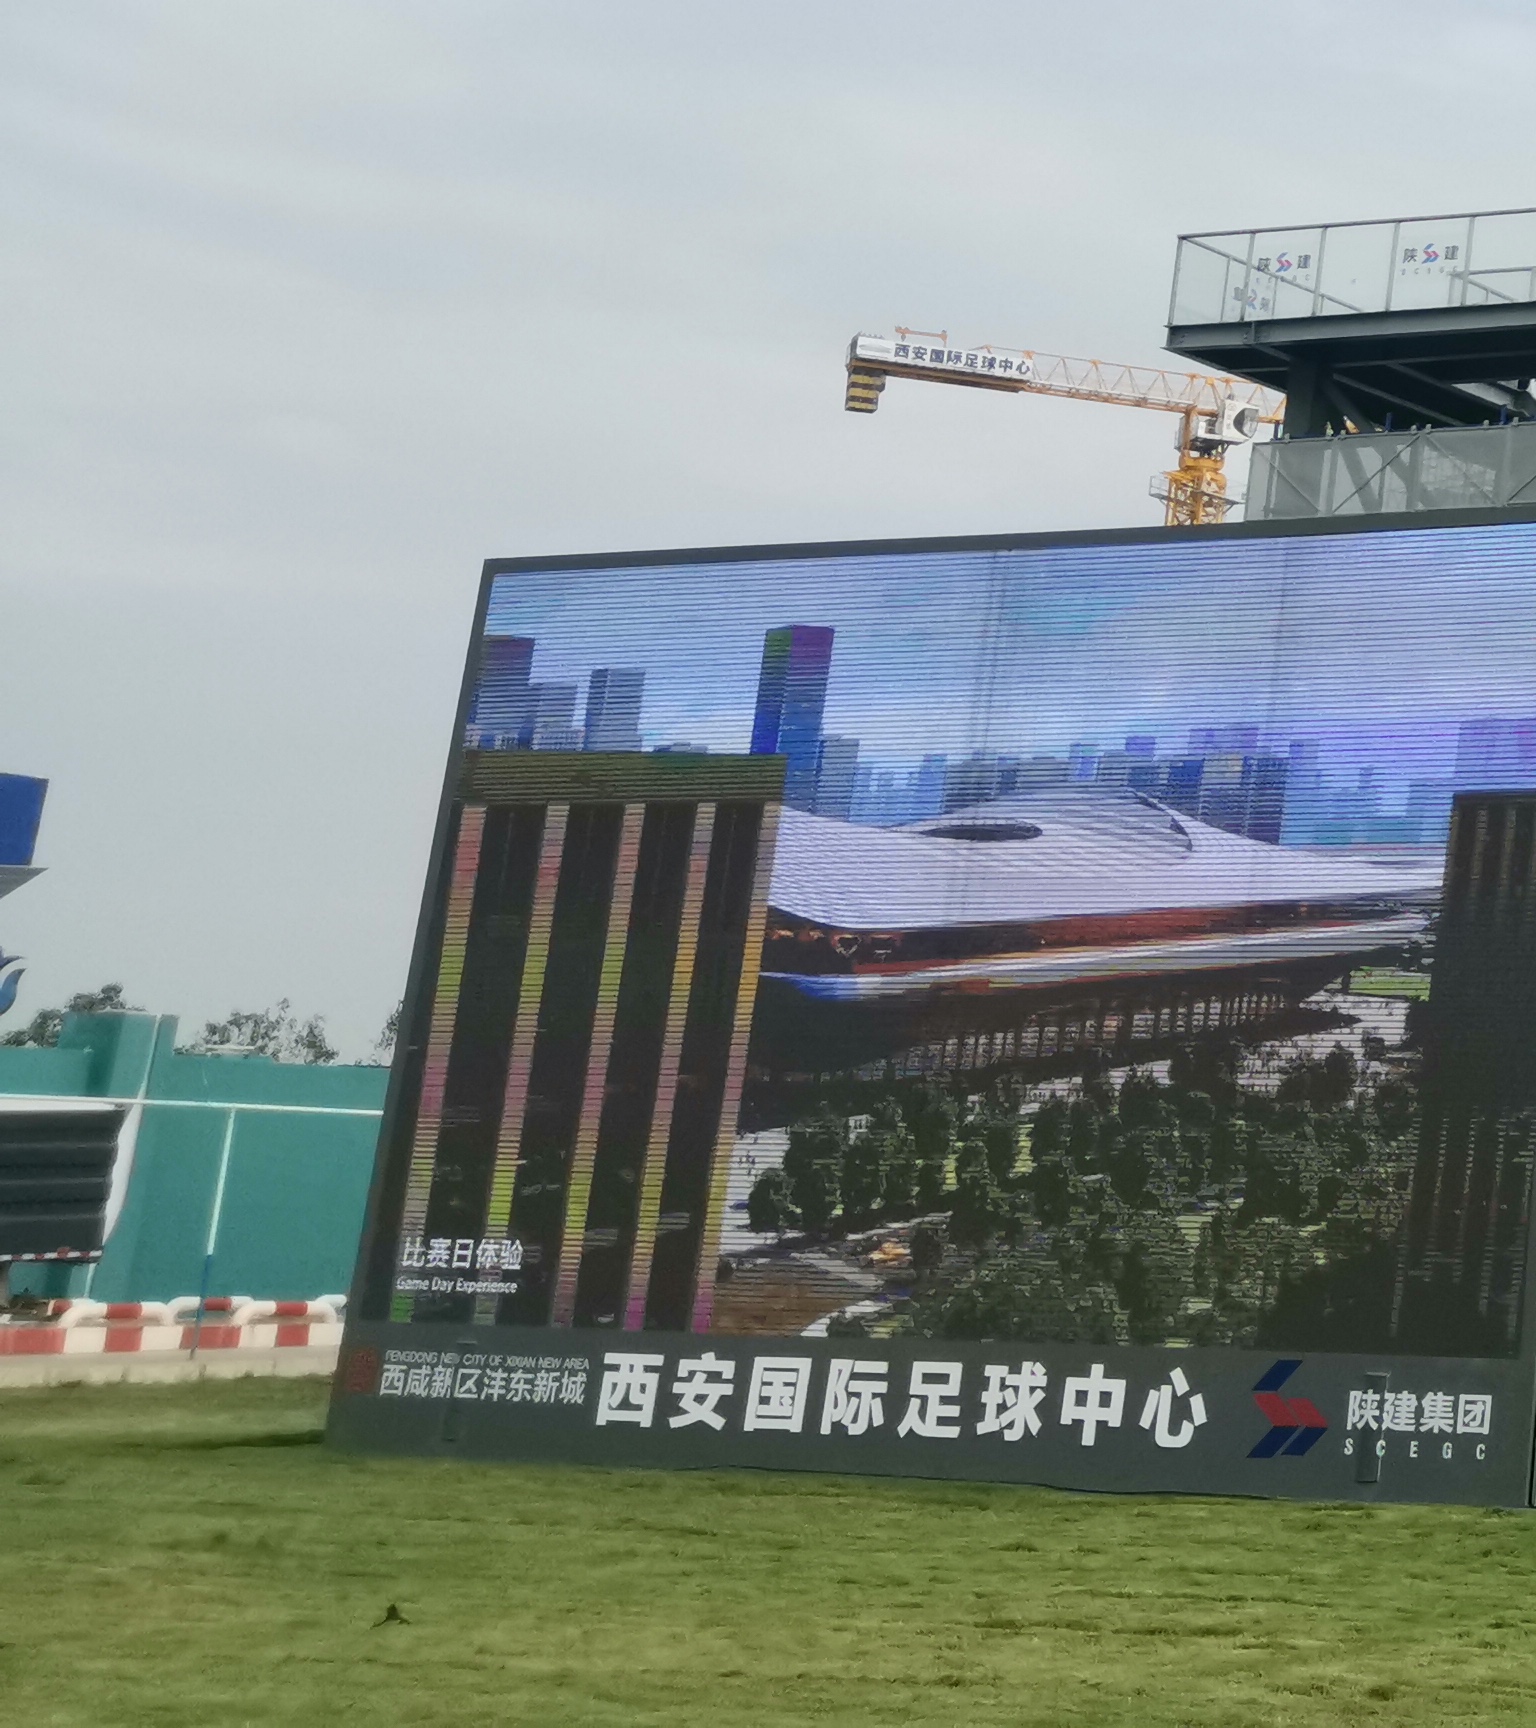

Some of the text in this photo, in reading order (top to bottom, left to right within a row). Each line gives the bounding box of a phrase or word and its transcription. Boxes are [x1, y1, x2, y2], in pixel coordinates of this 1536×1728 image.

[894, 343, 1030, 375] 西安国际足球中心
[400, 1236, 524, 1270] 比赛日体验
[432, 1276, 454, 1293] Day
[456, 1277, 518, 1294] Experience
[463, 1353, 488, 1366] CITY
[489, 1354, 504, 1367] OF
[538, 1356, 562, 1369] NEW
[562, 1357, 590, 1370] AREA
[595, 1351, 1208, 1449] 西安国际足球中心
[1345, 1389, 1493, 1436] 陕建集团
[1344, 1438, 1487, 1461] SCEGC
